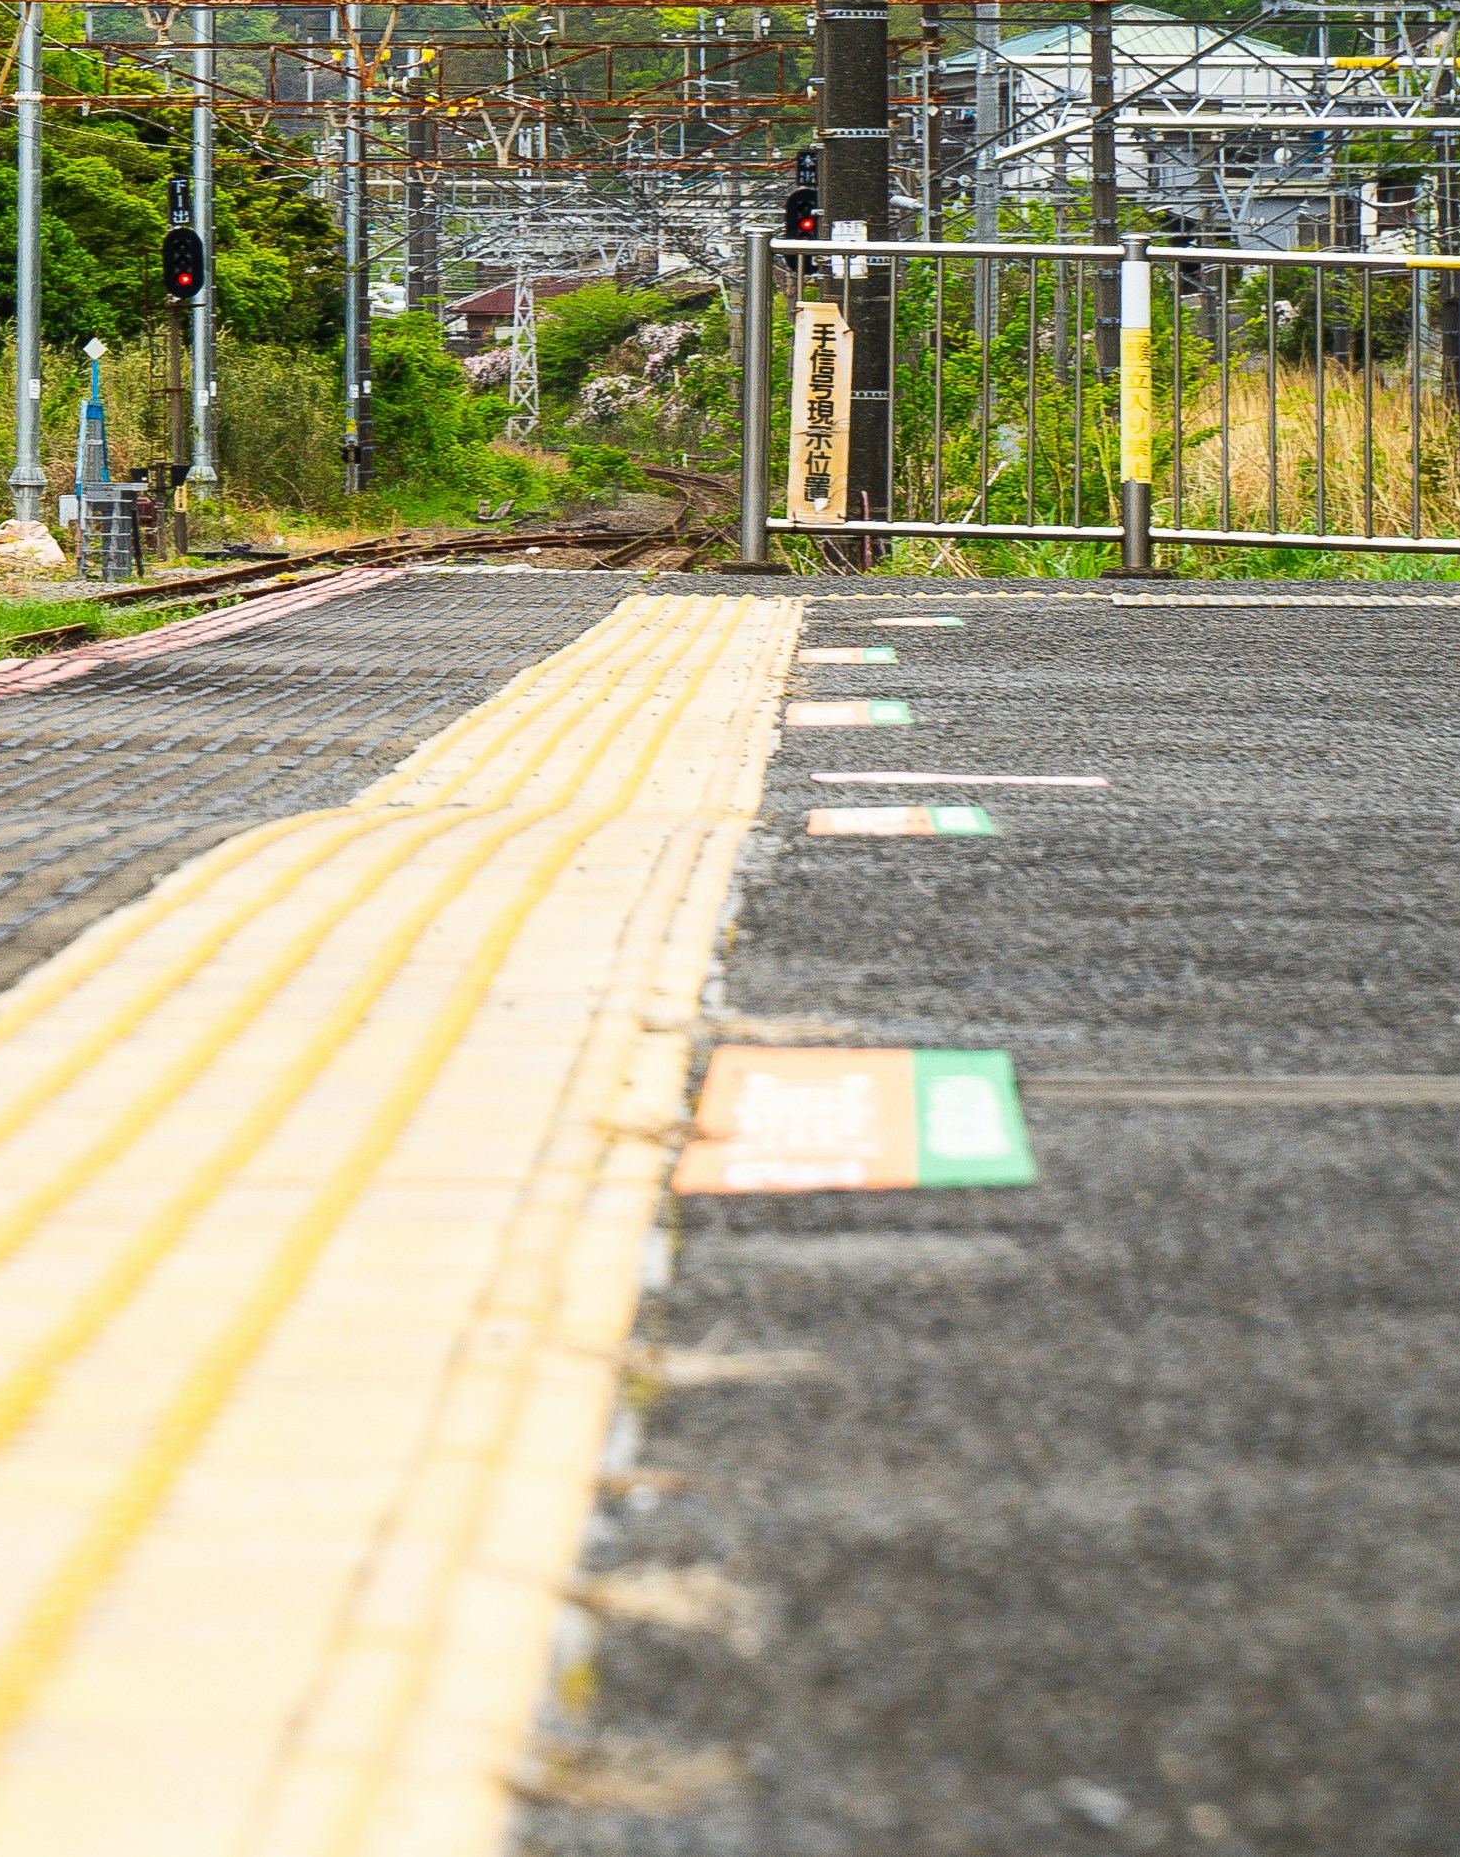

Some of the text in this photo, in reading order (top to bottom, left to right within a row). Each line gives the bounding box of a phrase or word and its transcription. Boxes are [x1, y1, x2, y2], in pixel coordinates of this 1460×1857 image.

[804, 322, 837, 503] 手信号現示位置
[1124, 371, 1149, 478] 立入り禁止
